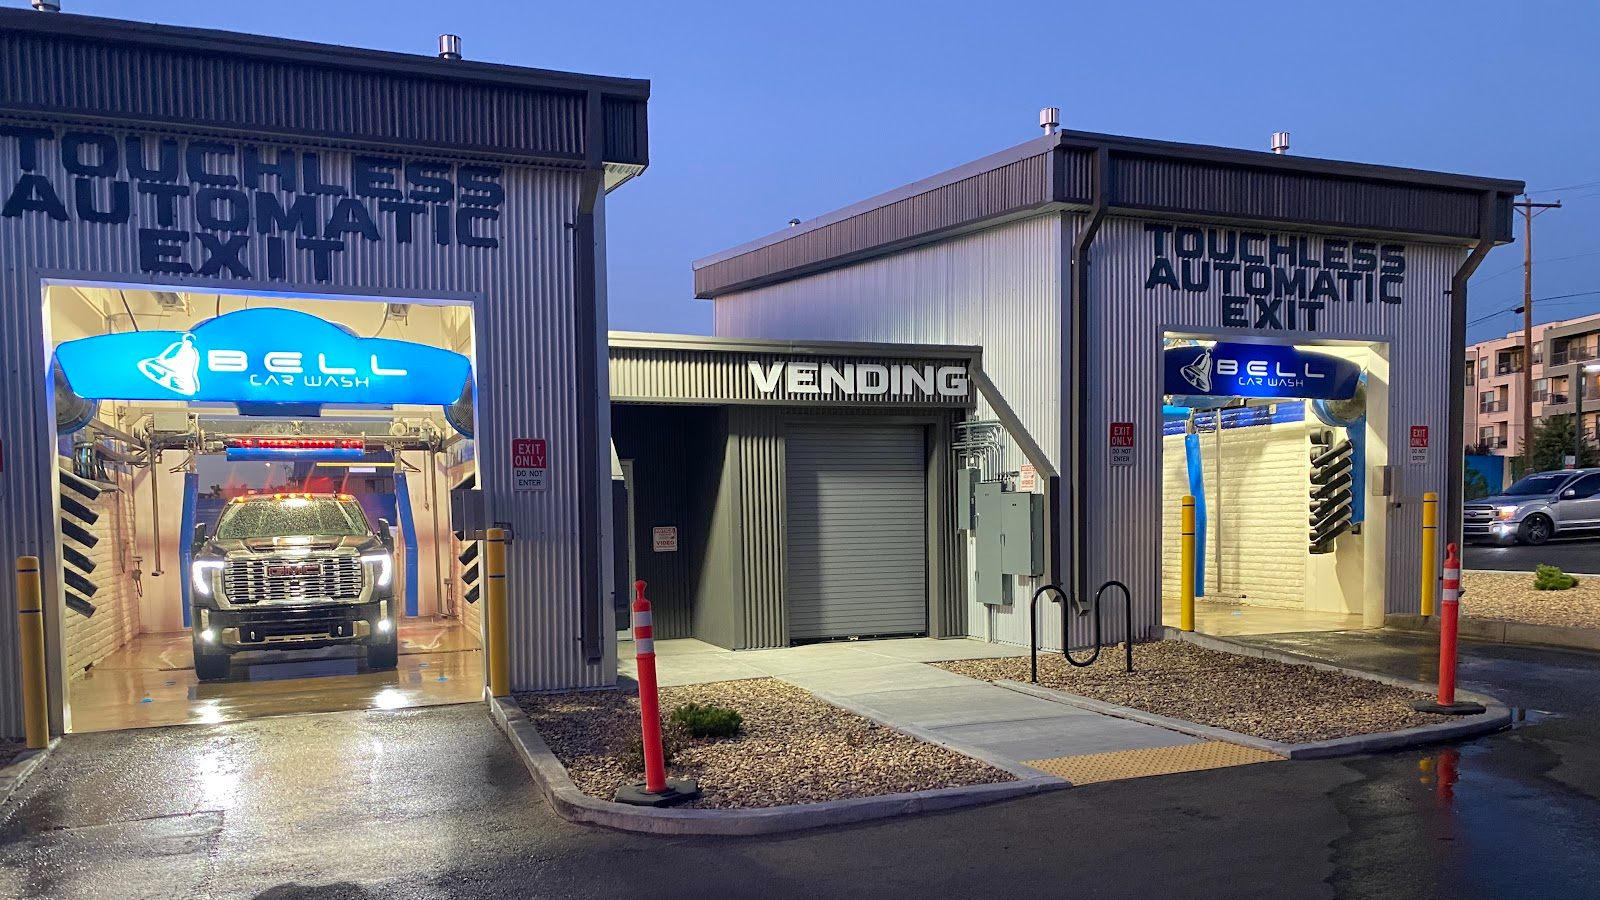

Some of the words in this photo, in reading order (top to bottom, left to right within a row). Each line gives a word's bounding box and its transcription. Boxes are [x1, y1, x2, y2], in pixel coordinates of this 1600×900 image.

[0, 126, 504, 207] TOUCHLESS
[1, 174, 500, 249] AUTOMATIC
[138, 228, 345, 281] EXIT
[1144, 222, 1406, 275] TOUCHLESS
[1145, 257, 1404, 304] AUTOMATIC
[1222, 295, 1324, 331] EXIT
[207, 349, 408, 376] BELL
[1217, 359, 1325, 378] BELL
[250, 374, 294, 387] CAR
[304, 375, 369, 388] WASH
[748, 360, 968, 396] VENDING
[1238, 377, 1263, 386] CAR
[1268, 379, 1304, 388] WASH
[1114, 427, 1130, 435] EXIT
[1413, 429, 1426, 437] EXIT
[1112, 436, 1132, 445] ONLY
[1411, 438, 1427, 446] ONLY
[518, 444, 540, 454] EXIT
[515, 456, 544, 466] ONLY
[268, 565, 320, 576] GMC
